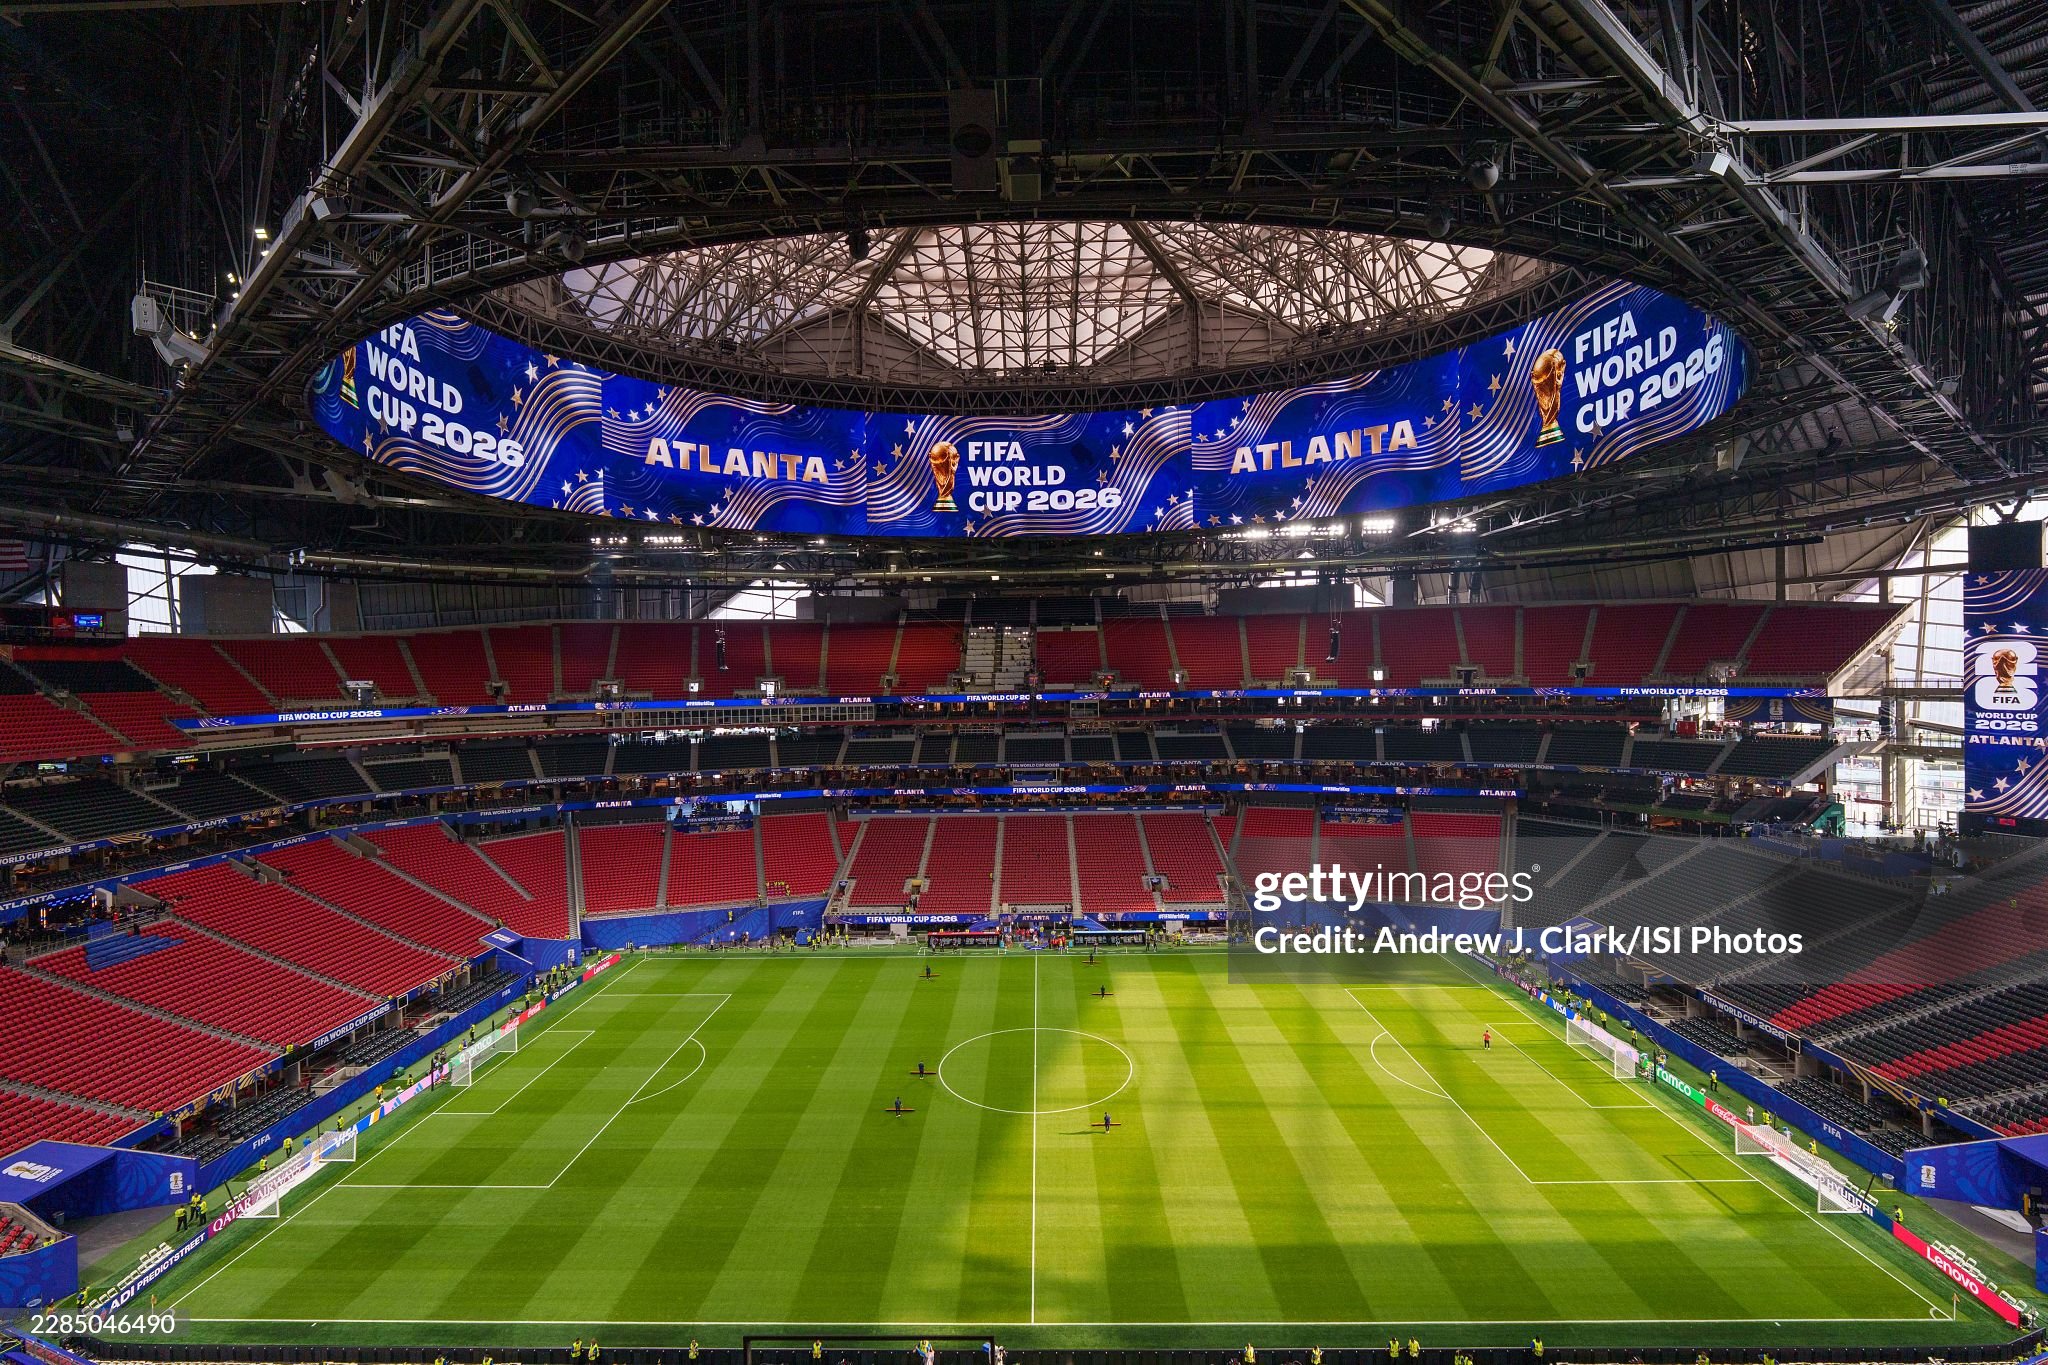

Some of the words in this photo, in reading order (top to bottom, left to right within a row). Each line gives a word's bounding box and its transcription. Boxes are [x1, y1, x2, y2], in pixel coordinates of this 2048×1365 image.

[380, 322, 421, 363] IFA
[1575, 310, 1639, 364] FIFA
[1575, 326, 1678, 398] WORLD
[365, 340, 463, 414] WORLD
[1576, 388, 1635, 433] CUP
[1639, 333, 1723, 411] 2026
[368, 385, 417, 433] CUP
[422, 412, 525, 468] 2026
[968, 441, 1026, 462] FIFA
[1230, 419, 1418, 474] ATLANTA
[644, 437, 830, 483] ATLANTA
[968, 466, 1066, 487] WORLD
[968, 491, 1023, 512] CUP
[1027, 488, 1122, 511] 2026
[508, 704, 547, 712] ATLANTA
[1992, 696, 2021, 704] FIFA
[278, 714, 294, 722] FIFA
[294, 712, 328, 721] WORLD
[330, 711, 349, 719] CUP
[350, 710, 382, 718] 2026
[1975, 712, 2014, 720] WORLD
[2015, 712, 2038, 720] CUP
[1975, 720, 2039, 731] 2026
[1969, 735, 2046, 747] ATLANTA
[1647, 770, 1689, 778] ATLANTA
[1479, 789, 1517, 797] ATLANTA
[595, 800, 632, 808] ATLANTA
[185, 818, 228, 831] ATLANTA
[272, 836, 307, 848] ATLANTA
[0, 857, 25, 866] ORLD
[26, 852, 43, 860] CUP
[44, 846, 72, 857] 2026
[930, 915, 958, 923] 2026
[593, 961, 611, 975] Lenovo
[1552, 1000, 1567, 1016] VISA
[1703, 994, 1718, 1007] FIFA
[1717, 1002, 1743, 1019] WORLD
[1743, 1013, 1758, 1026] CUP
[1758, 1022, 1786, 1040] 2026
[313, 1034, 329, 1049] FIFA
[329, 1023, 354, 1042] WORLD
[355, 1015, 369, 1028] CUP
[369, 1004, 390, 1020] 2026
[1656, 1068, 1691, 1096] ramco
[1822, 1122, 1842, 1140] FIFA
[252, 1134, 271, 1150] FIFA
[212, 1197, 251, 1232] QATAR
[108, 1285, 135, 1314] ADI
[137, 1233, 206, 1292] PREDICTSTREET
[1926, 1246, 1979, 1295] Lenovo
